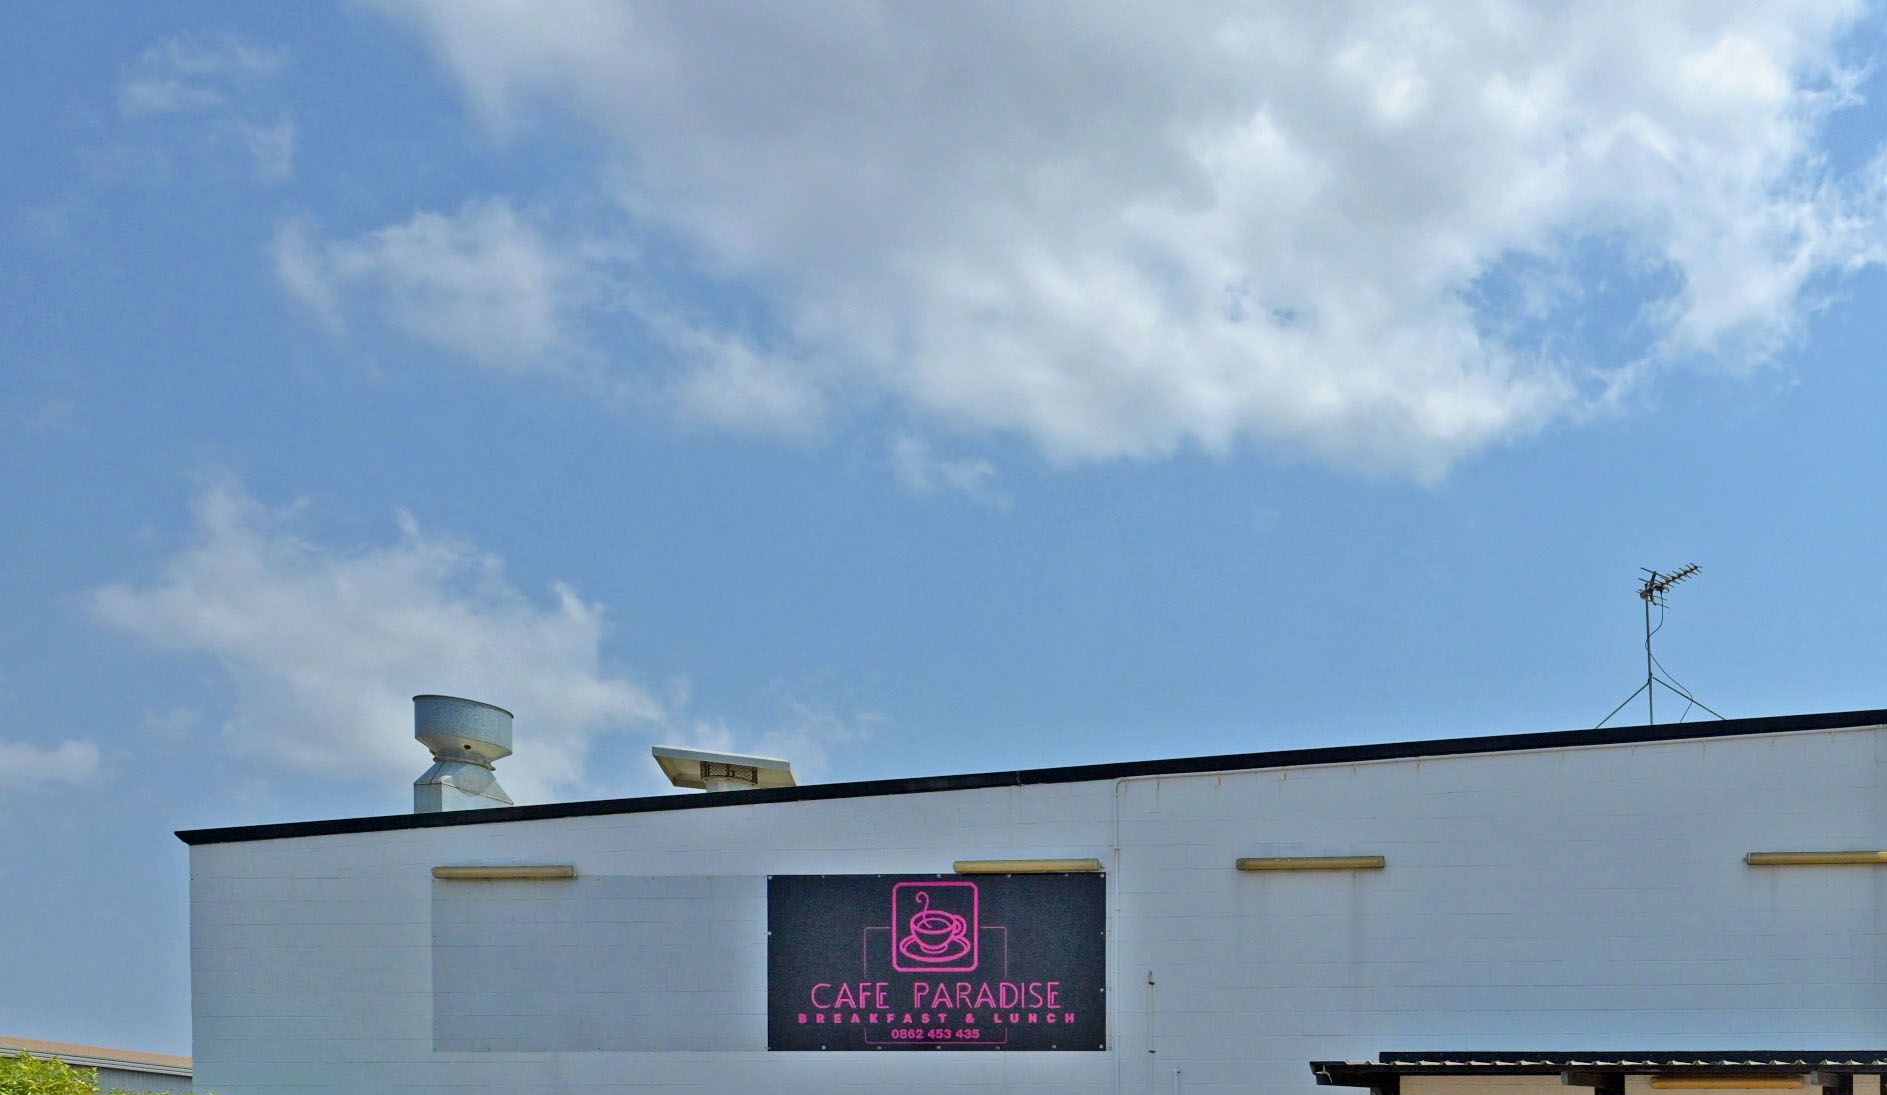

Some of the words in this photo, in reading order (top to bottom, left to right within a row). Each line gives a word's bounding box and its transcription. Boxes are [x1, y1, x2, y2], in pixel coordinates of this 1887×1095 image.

[811, 982, 890, 1009] CAFE
[913, 982, 1062, 1009] PARADISE
[798, 1013, 949, 1024] BREAKFAST
[965, 1013, 976, 1024] &
[993, 1013, 1076, 1024] LUNCH
[955, 1028, 980, 1039] 435
